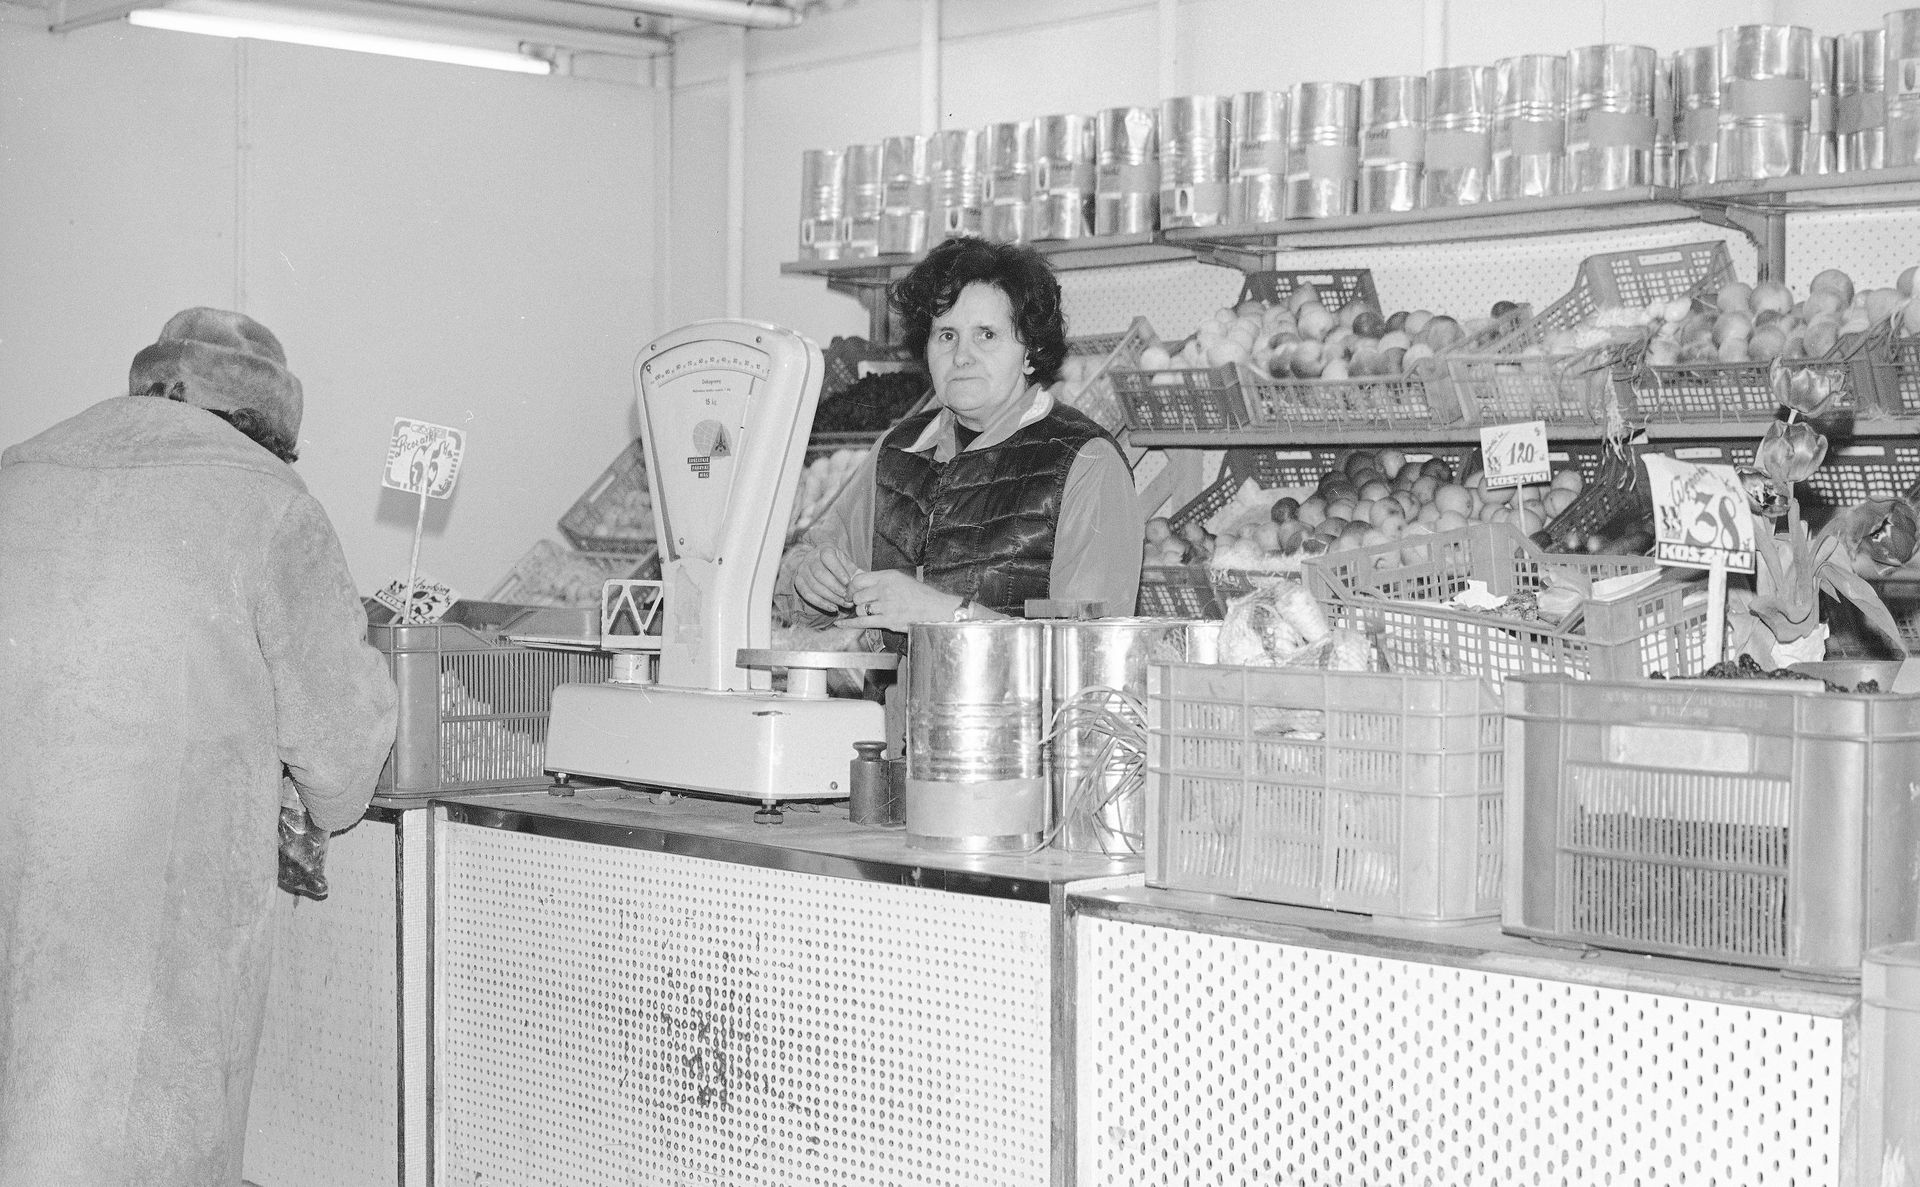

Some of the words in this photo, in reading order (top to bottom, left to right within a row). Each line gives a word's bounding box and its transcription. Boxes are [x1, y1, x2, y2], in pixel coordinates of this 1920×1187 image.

[1506, 441, 1535, 466] 120
[1684, 491, 1740, 551] 38
[1660, 544, 1752, 568] KOSZYKI
